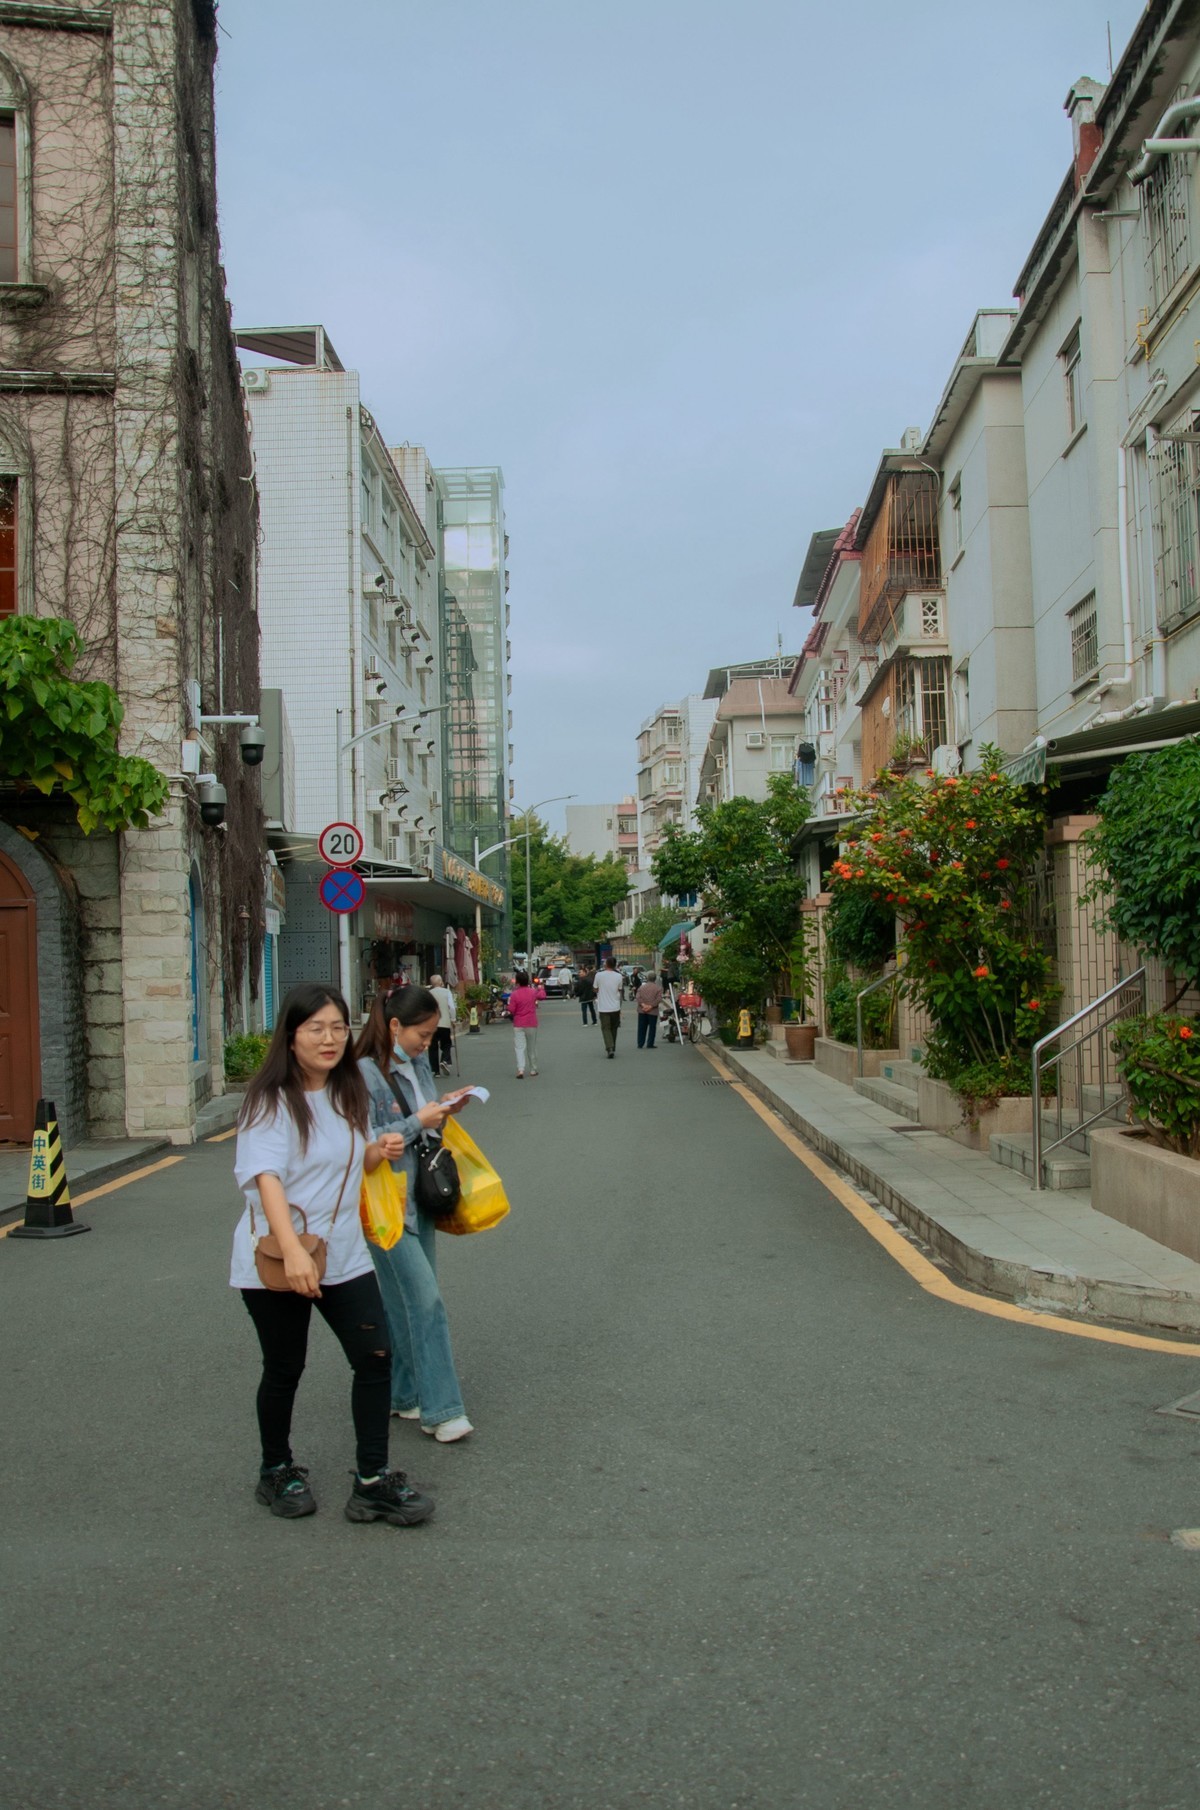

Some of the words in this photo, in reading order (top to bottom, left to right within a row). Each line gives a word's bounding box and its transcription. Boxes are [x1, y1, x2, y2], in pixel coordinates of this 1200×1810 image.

[330, 834, 354, 855] 20
[32, 1136, 46, 1190] 中英街
